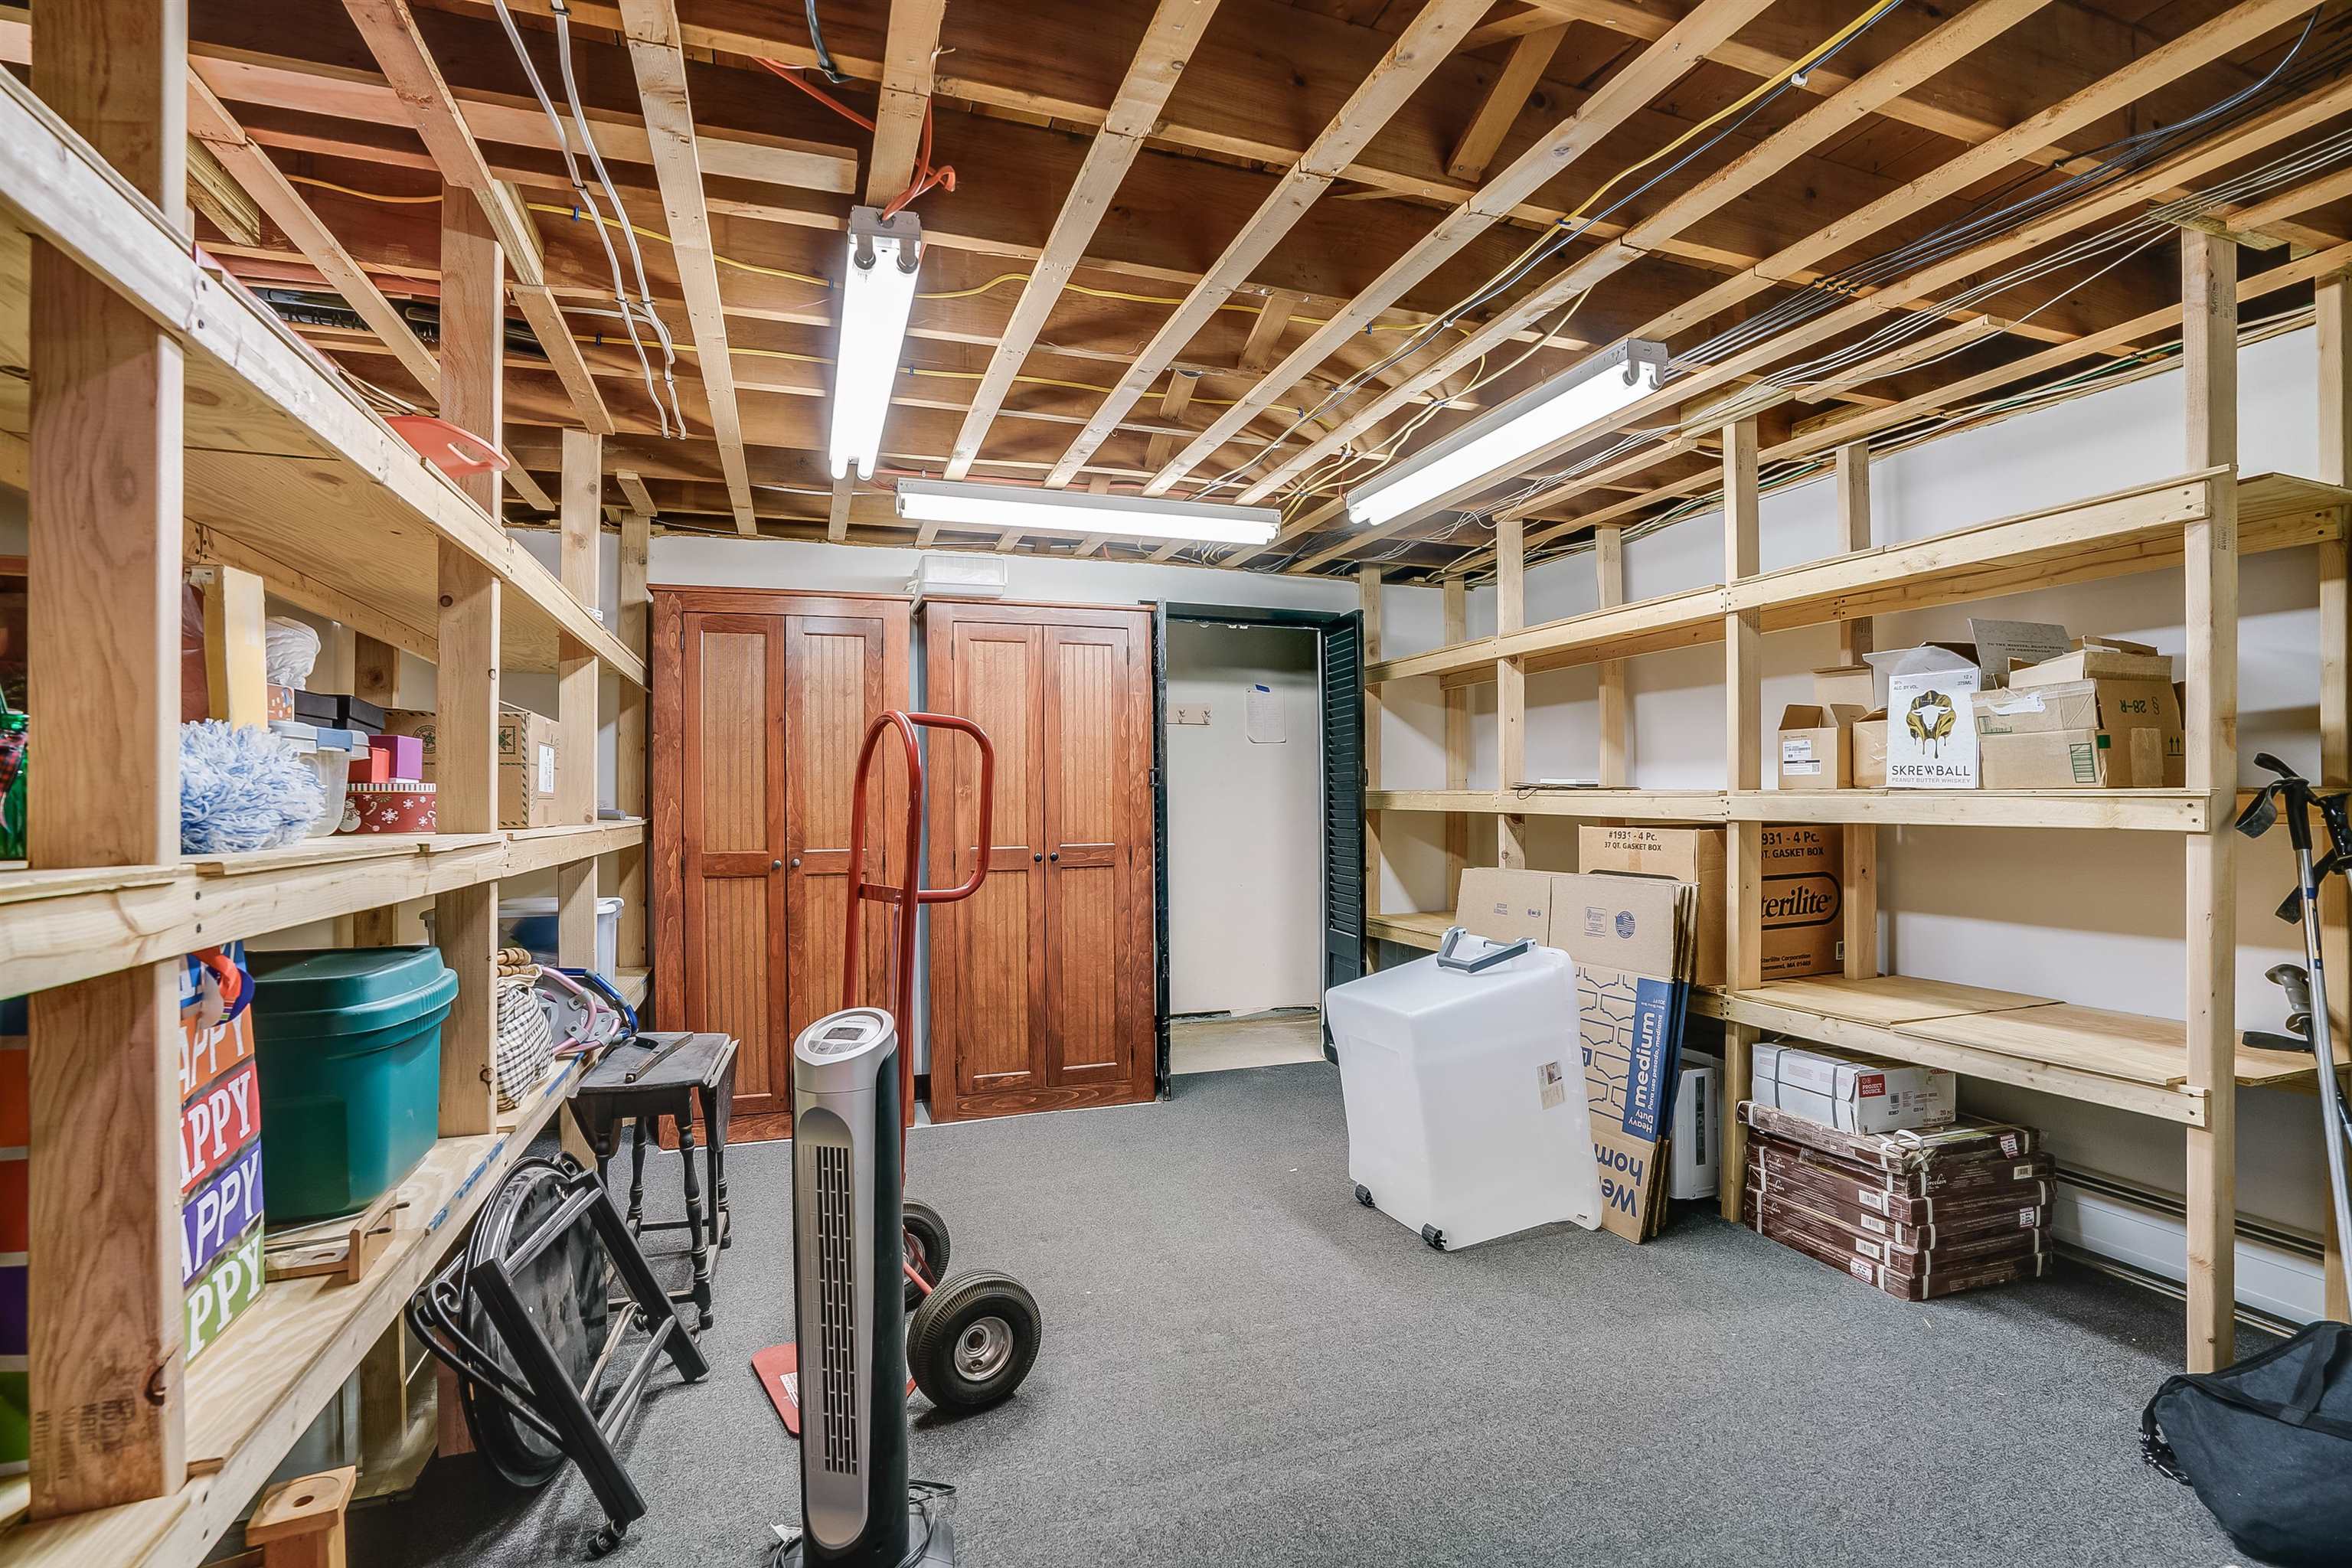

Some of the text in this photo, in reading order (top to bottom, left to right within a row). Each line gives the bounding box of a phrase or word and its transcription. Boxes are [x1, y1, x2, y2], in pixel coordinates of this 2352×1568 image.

[1892, 765, 1971, 776] SKREWBALL
[1638, 831, 1644, 840] 4
[1645, 832, 1658, 841] Pc.
[1793, 831, 1801, 844] 4
[1803, 831, 1820, 843] Pc.
[1622, 842, 1647, 851] GASKET
[1772, 848, 1805, 858] GASKET
[1807, 846, 1824, 856] BOX
[1635, 1011, 1655, 1109] medium
[1652, 1049, 1661, 1079] pesado,
[1635, 1109, 1654, 1124] Duty
[1628, 1116, 1653, 1133] Heavy
[1599, 1175, 1637, 1218] We
